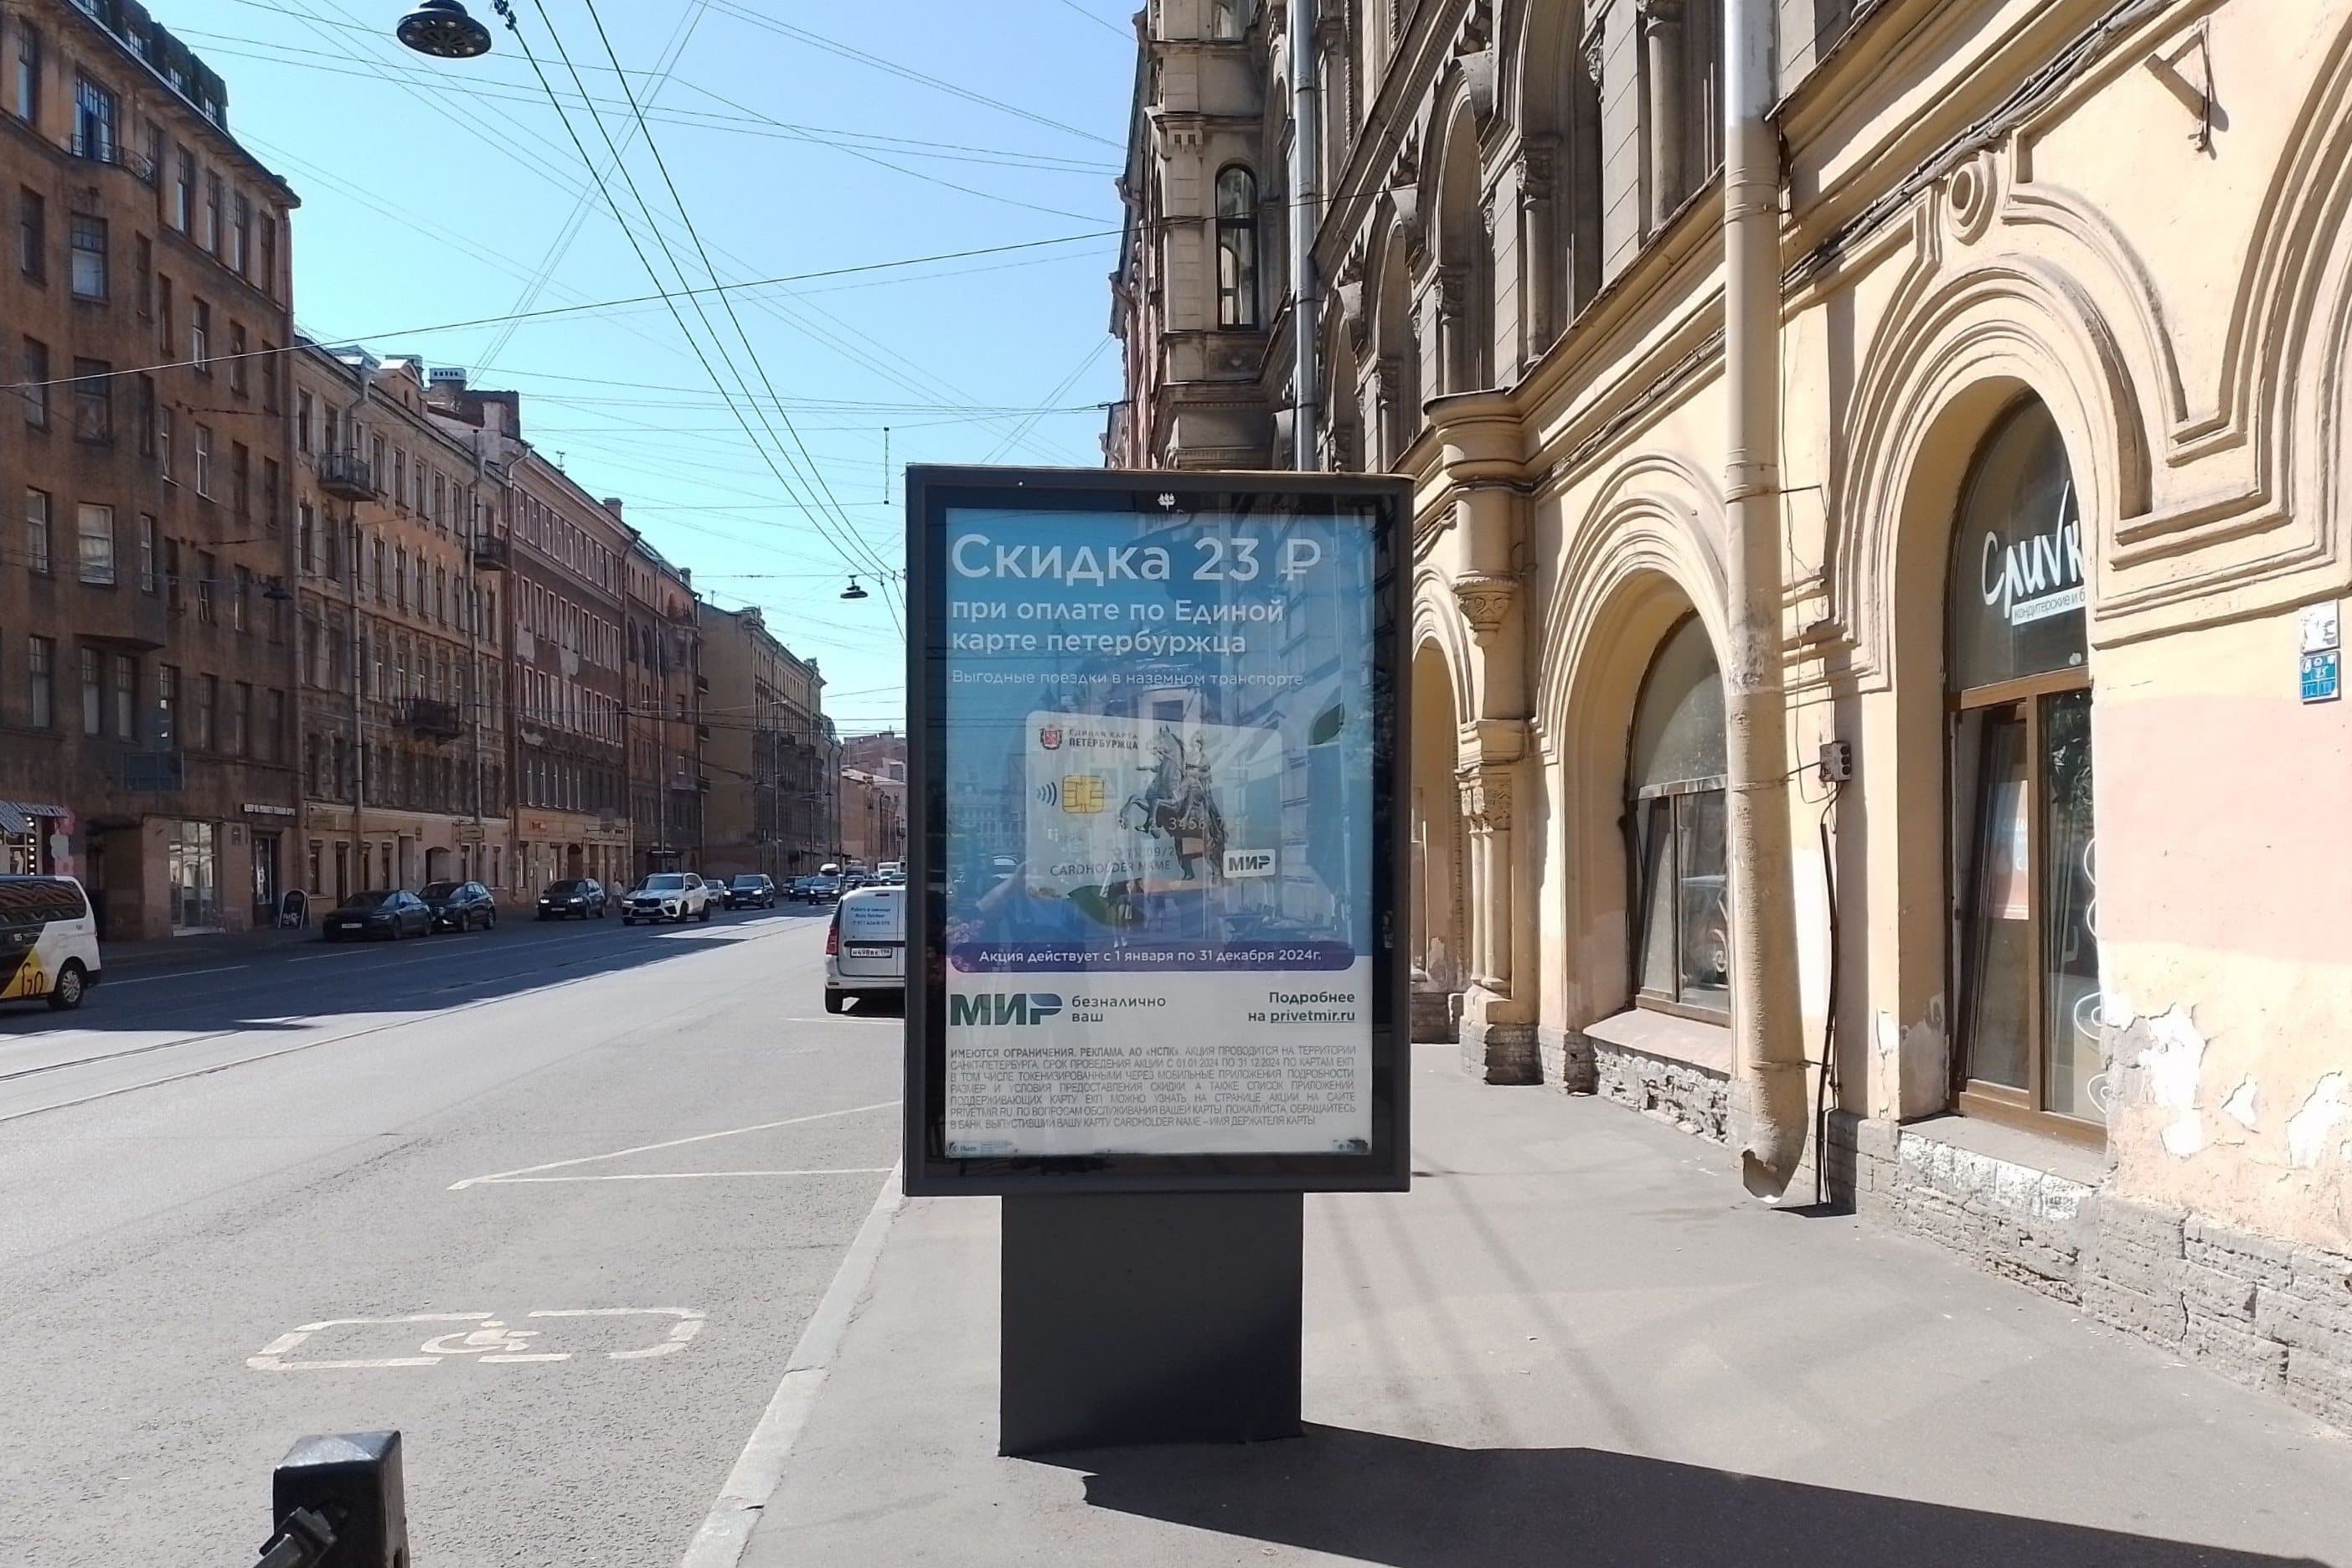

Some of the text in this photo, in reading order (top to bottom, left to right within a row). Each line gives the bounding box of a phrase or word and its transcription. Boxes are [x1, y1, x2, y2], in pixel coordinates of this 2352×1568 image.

[952, 534, 1171, 587] Скидка
[1193, 537, 1260, 582] 23
[952, 598, 1284, 624] при оплате по Единой
[952, 628, 1246, 657] карте петербуржца
[952, 669, 1304, 689] Выгодные поездки в наземном транспорте
[1069, 737, 1138, 750] ПЕТЕРБУРЖЦА
[1138, 859, 1171, 872] NAME
[1228, 856, 1271, 872] МИР
[979, 949, 1322, 965] Акция действует с 1 января по 31 декабря 2024г.
[1071, 994, 1166, 1009] безналично
[1268, 991, 1355, 1007] Подробнее
[950, 993, 1063, 1026] МИР
[1248, 1009, 1355, 1024] на privetmir.ru
[1071, 1012, 1104, 1023] ваш
[951, 1049, 999, 1058] ИМЕЮТСЯ
[1129, 1048, 1142, 1057] АО
[1185, 1047, 1215, 1056] АКЦИЯ
[1218, 1046, 1278, 1056] ПРОВОДИТСЯ
[1282, 1046, 1294, 1056] НА
[1298, 1046, 1356, 1055] ТЕРРИТОРИИ
[1044, 1060, 1066, 1069] СРОК
[1070, 1059, 1131, 1069] ПРОВЕДЕНИЯ
[1134, 1059, 1163, 1068] АКЦИИ
[1166, 1059, 1173, 1068] С
[1221, 1059, 1235, 1068] ПО
[1283, 1058, 1297, 1067] ПО
[1300, 1058, 1333, 1067] КАРТАМ
[951, 1072, 957, 1082] В
[962, 1072, 980, 1081] ТОМ
[984, 1072, 1014, 1081] ЧИСЛЕ
[1019, 1071, 1122, 1081] ТОКЕНИЗИРОВАННЫМИ
[1126, 1070, 1154, 1081] ЧЕРЕЗ
[1158, 1070, 1215, 1080] МОБИЛЬНЫЕ
[994, 1084, 1001, 1093] И
[1060, 1083, 1142, 1092] ПРЕДОСТАВЛЕНИЯ
[1195, 1082, 1201, 1091] А
[1210, 1082, 1239, 1091] ТАКЖЕ
[1246, 1082, 1283, 1091] СПИСОК
[951, 1096, 1042, 1106] ПОДДЕРЖИВАЮЩИХ
[1050, 1095, 1077, 1105] КАРТУ
[1086, 1095, 1102, 1104] ЕКП
[1111, 1095, 1146, 1104] МОЖНО
[1153, 1094, 1187, 1103] УЗНАТЬ
[1194, 1094, 1206, 1103] НА
[1215, 1093, 1261, 1103] СТРАНИЦЕ
[1269, 1093, 1299, 1102] АКЦИИ
[1307, 1093, 1319, 1102] НА
[1017, 1107, 1030, 1117] ПО
[1032, 1106, 1082, 1117] ВОПРОСАМ
[1084, 1106, 1158, 1116] ОБСЛУЖИВАНИЯ
[951, 1121, 957, 1129] В
[1057, 1118, 1081, 1127] ВАШУ
[1114, 1117, 1173, 1127] CARDHOLDER
[1176, 1117, 1200, 1127] NAME
[1210, 1117, 1230, 1126] ИМЯ
[1231, 1116, 1285, 1126] ДЕРЖАТЕЛЯ
